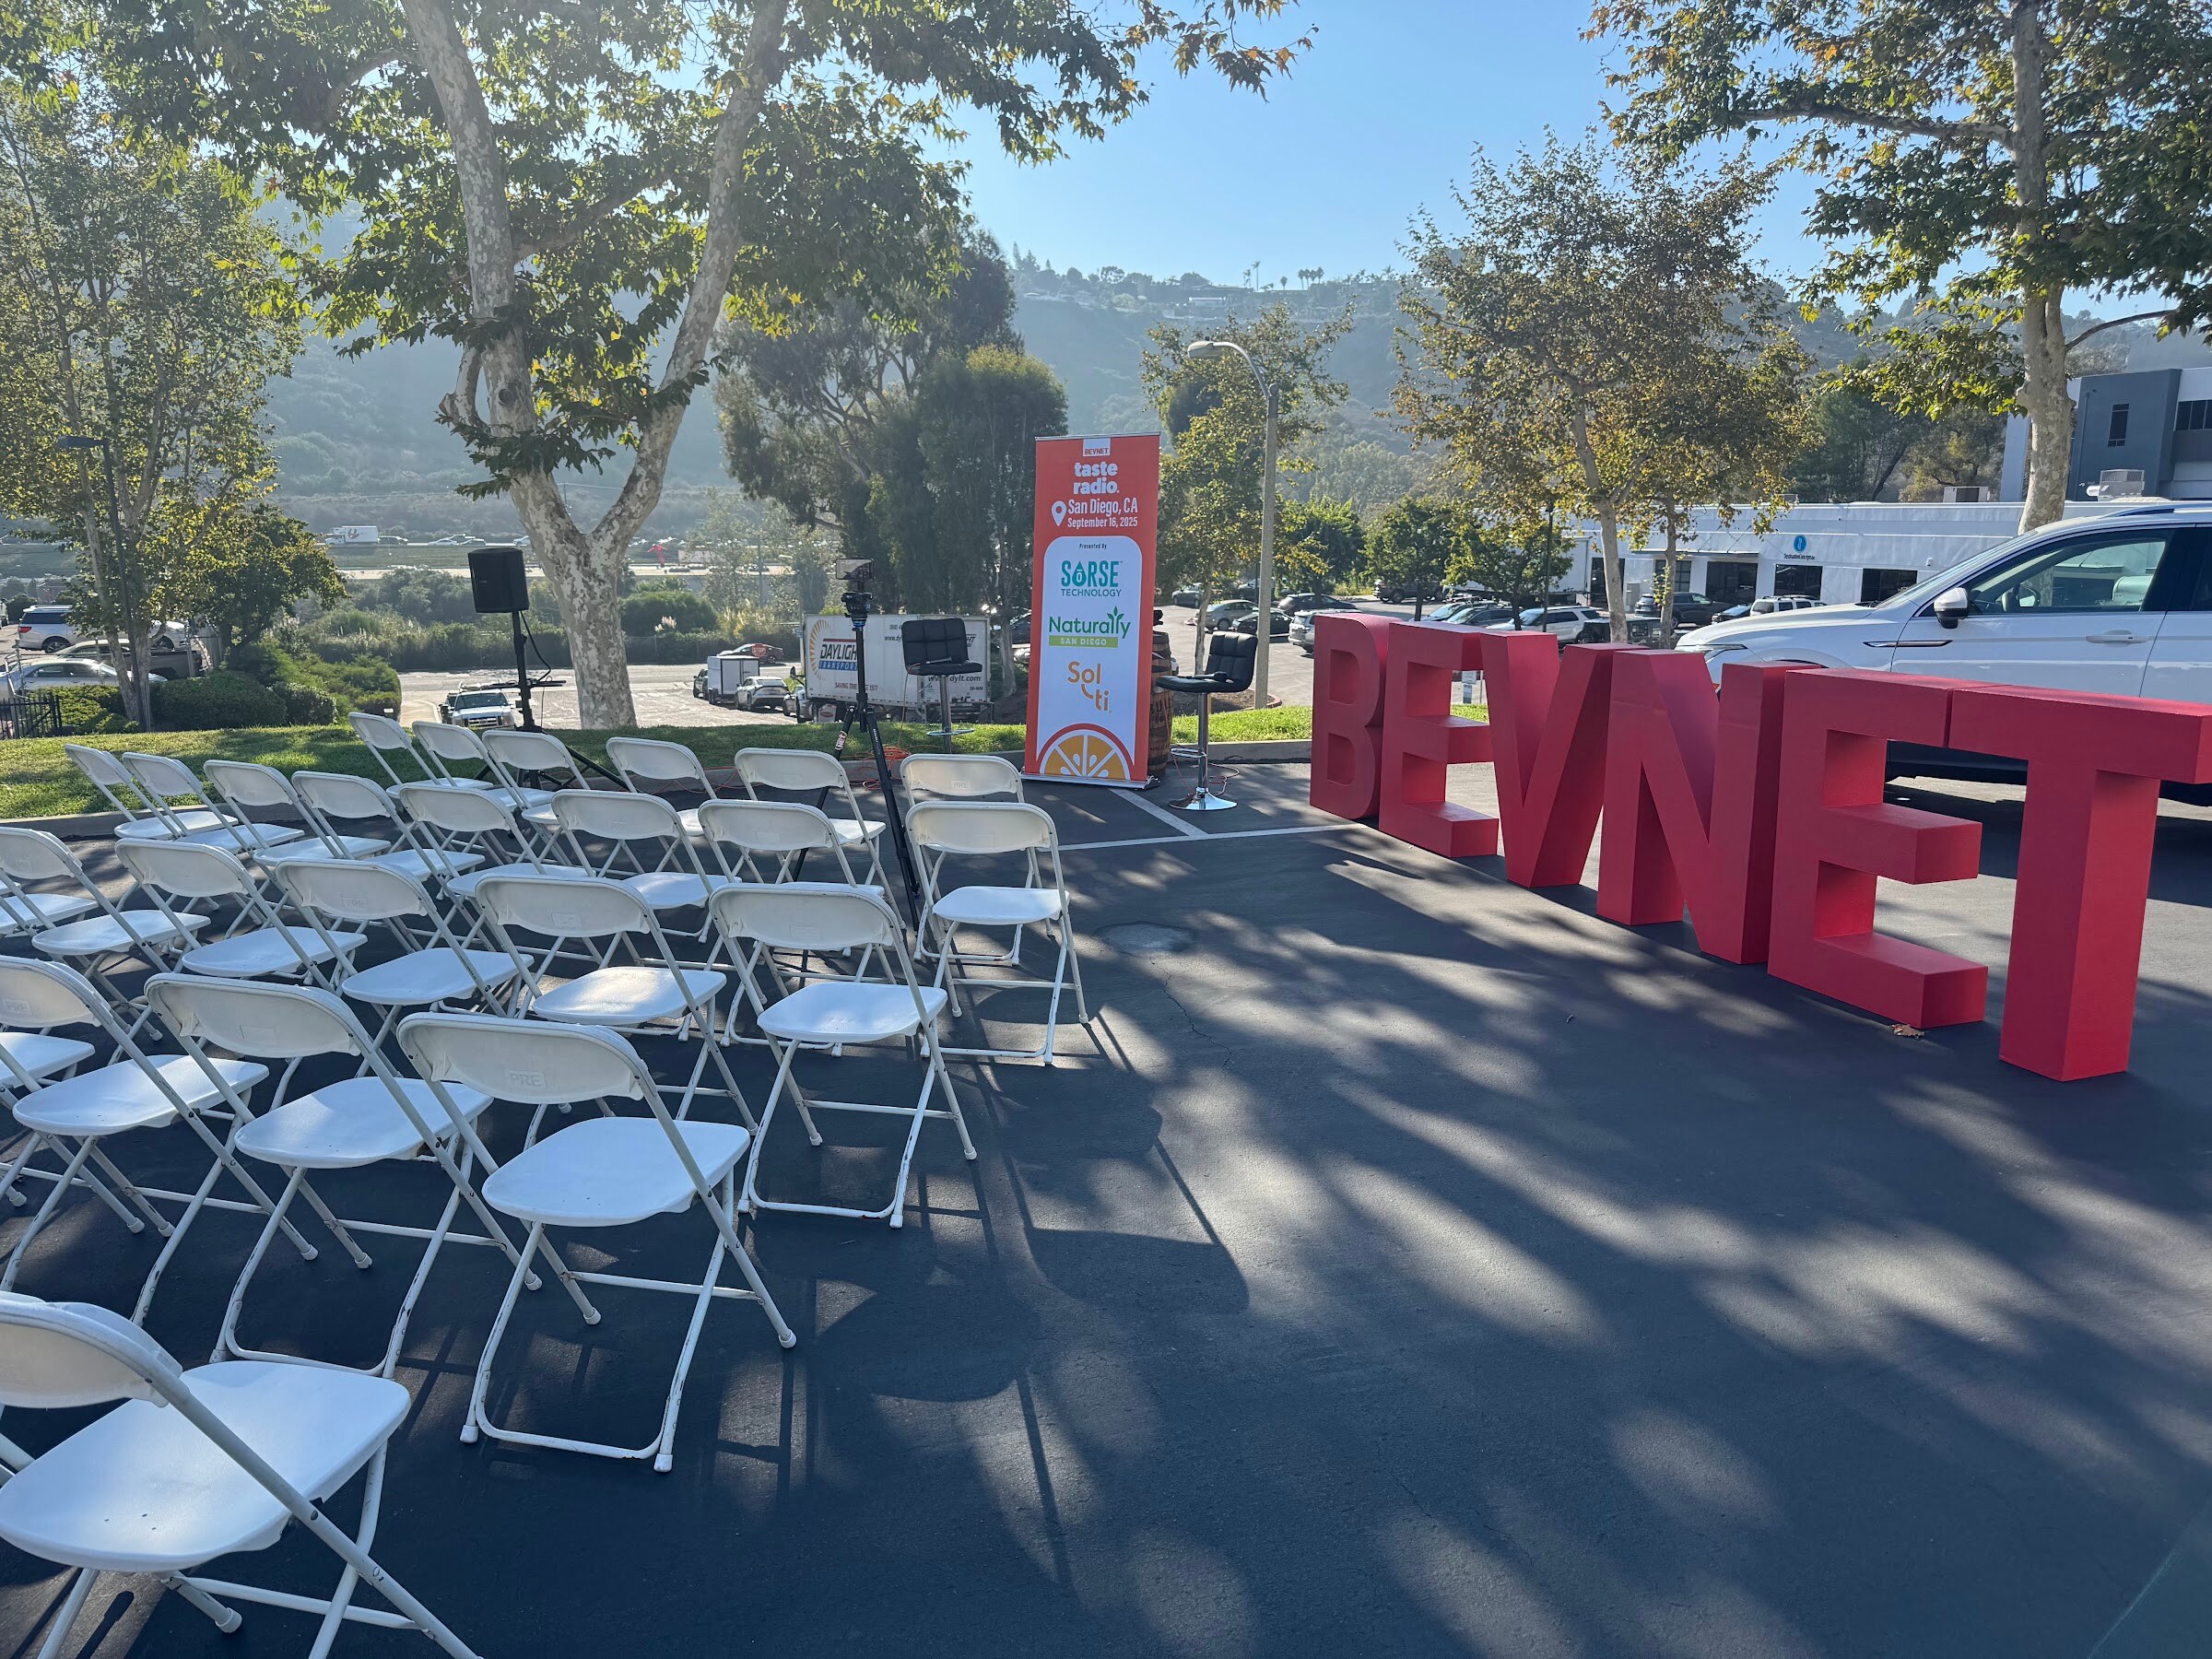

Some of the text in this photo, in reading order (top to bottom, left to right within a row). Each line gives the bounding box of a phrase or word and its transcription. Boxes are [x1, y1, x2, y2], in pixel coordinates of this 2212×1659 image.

[1075, 462, 1118, 477] taste
[1073, 477, 1120, 494] radio.
[1068, 497, 1138, 517] San Diego, CA
[1067, 516, 1138, 529] September 16, 2025
[1061, 589, 1122, 597] TECHNOLOGY
[1049, 609, 1132, 639] Naturally
[1080, 638, 1107, 646] DIEGO
[819, 643, 857, 661] DAYLIGH
[1067, 661, 1101, 684] Sol
[1311, 614, 2212, 1081] BEVNET
[510, 1073, 542, 1087] PRE
